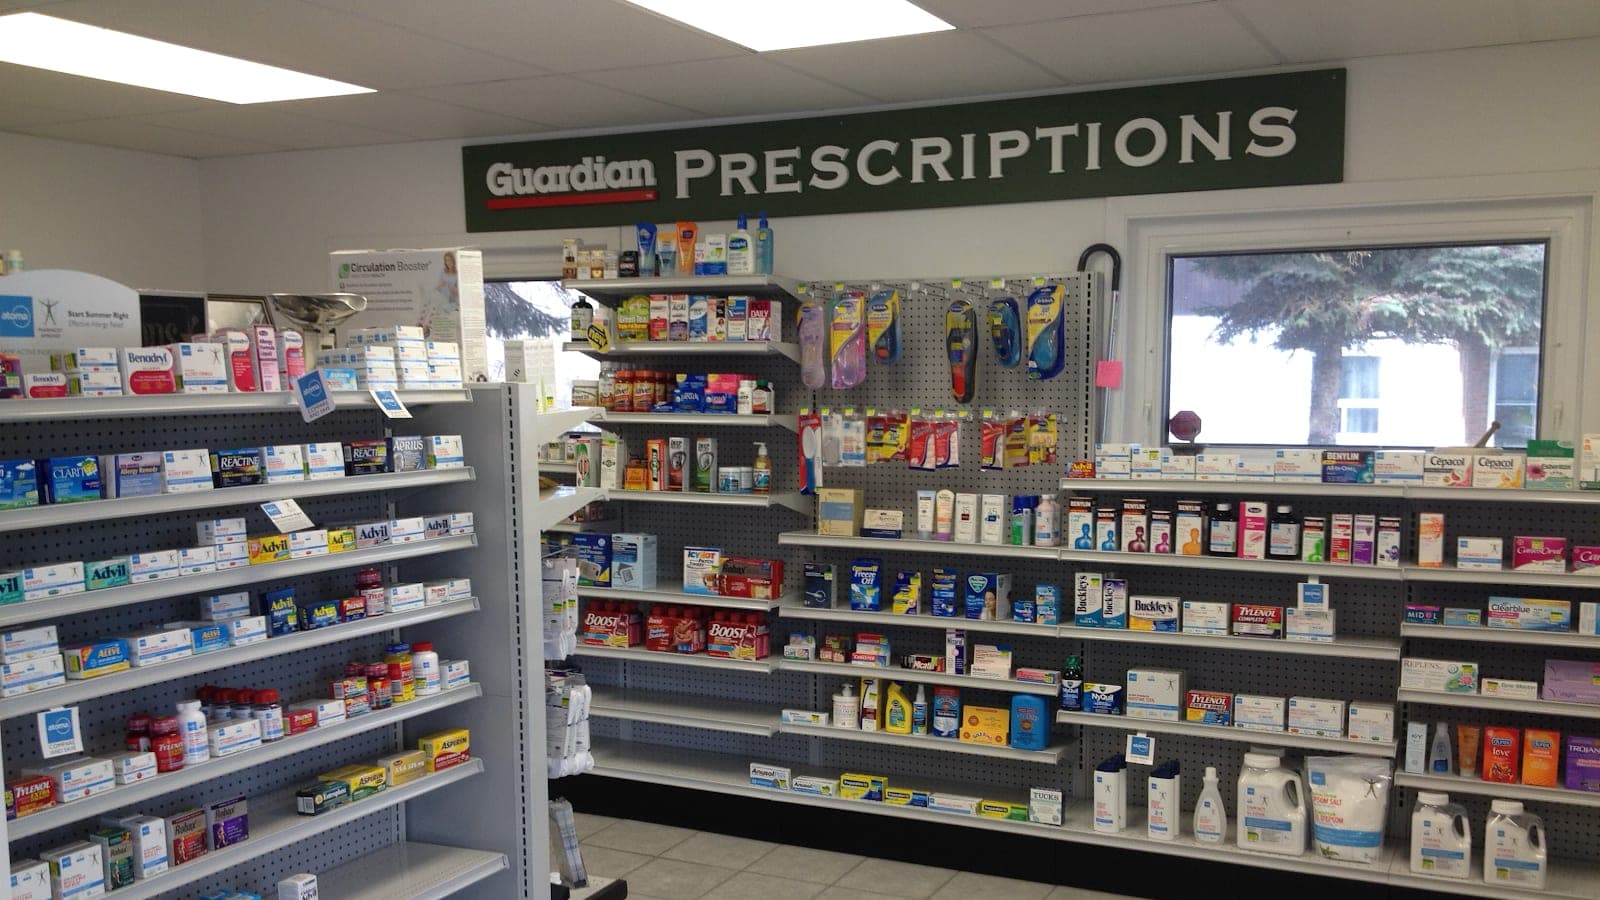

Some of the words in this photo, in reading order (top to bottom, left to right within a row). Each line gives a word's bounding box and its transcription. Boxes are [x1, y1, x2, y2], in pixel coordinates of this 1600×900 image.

[486, 156, 656, 197] Guardian
[674, 106, 1299, 199] PRESCRIPTIONS
[350, 262, 396, 274] Circulation
[397, 261, 430, 272] Booster
[1, 311, 29, 321] atoma
[67, 310, 85, 319] Start
[85, 311, 112, 319] Summer
[112, 310, 129, 320] Right
[128, 351, 168, 365] Benadryl
[221, 456, 260, 469] REACTINE
[1327, 452, 1360, 461] BENYLIN
[53, 465, 97, 479] CLARIT
[359, 525, 388, 540] Advil
[427, 519, 449, 533] Advil
[261, 539, 288, 554] Advil
[92, 564, 126, 581] Advil
[854, 570, 877, 579] Freeze
[0, 577, 18, 593] vil
[861, 577, 874, 586] Off
[271, 596, 295, 611] Advil
[1134, 599, 1174, 614] Buckley's
[1491, 603, 1531, 614] Clearblue
[1239, 606, 1276, 618] TYLENOL
[585, 612, 619, 627] BOOST
[201, 629, 222, 640] ALEVE
[708, 623, 747, 638] BOOST
[98, 646, 120, 658] ALEVE
[1403, 659, 1440, 670] REPLENS
[1091, 692, 1115, 702] NyQuil
[1190, 693, 1226, 706] TYLENOL
[441, 736, 468, 750] ASPIRIN
[1569, 744, 1600, 754] TROJAN
[1492, 747, 1510, 757] love
[751, 767, 775, 777] Anusol
[359, 772, 385, 786] ASPIRIN
[15, 781, 51, 798] TYLENOL
[1033, 791, 1060, 801] TUCKS
[214, 806, 237, 819] Robax
[175, 821, 199, 835] Robax
